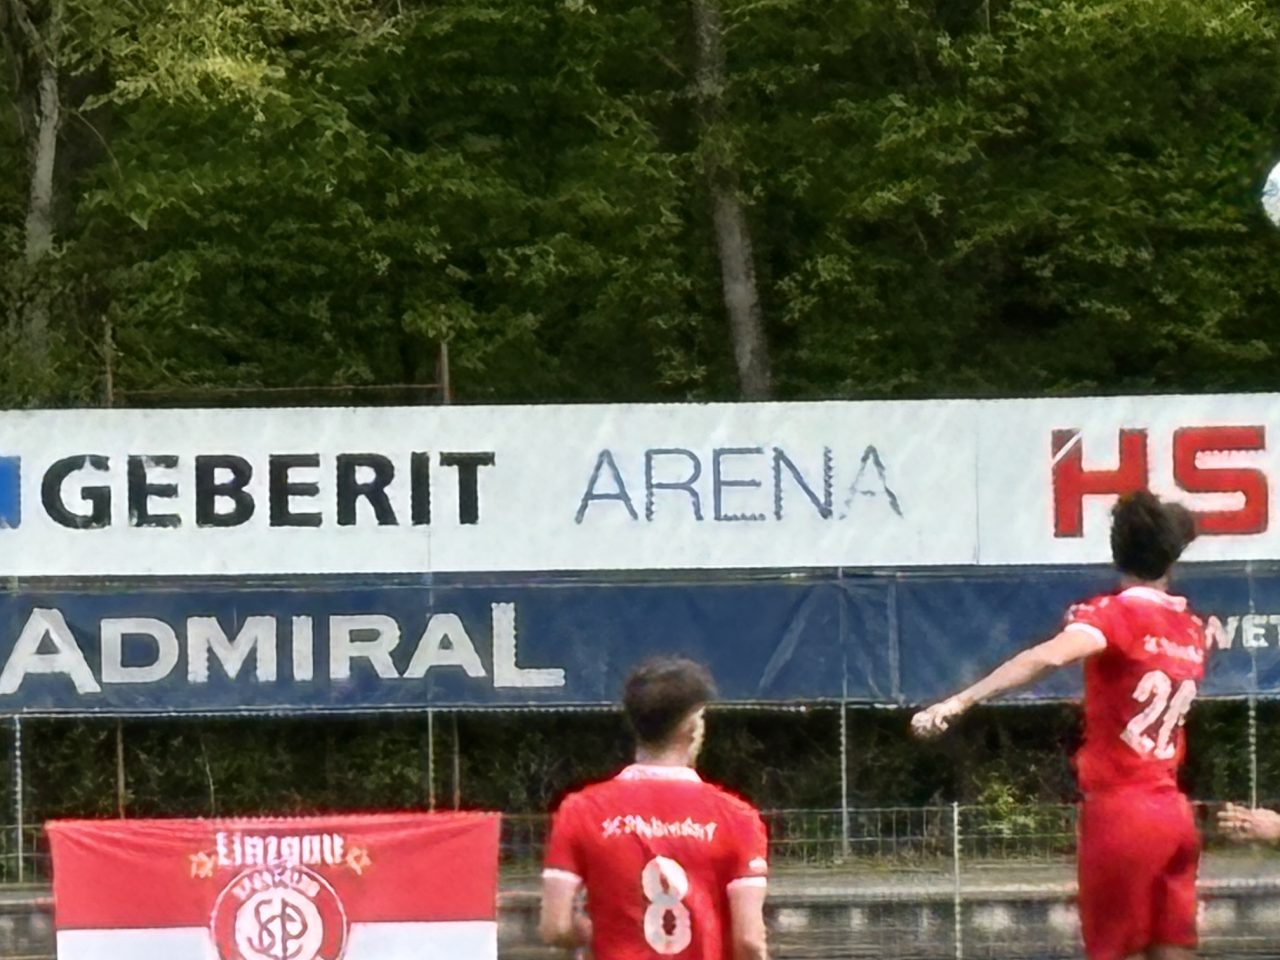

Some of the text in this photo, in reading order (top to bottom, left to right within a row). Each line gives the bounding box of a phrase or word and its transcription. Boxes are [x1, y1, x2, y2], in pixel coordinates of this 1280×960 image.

[41, 445, 903, 529] GEBERIT ARENA
[0, 602, 566, 695] ADMIRAL
[641, 855, 692, 955] 8
